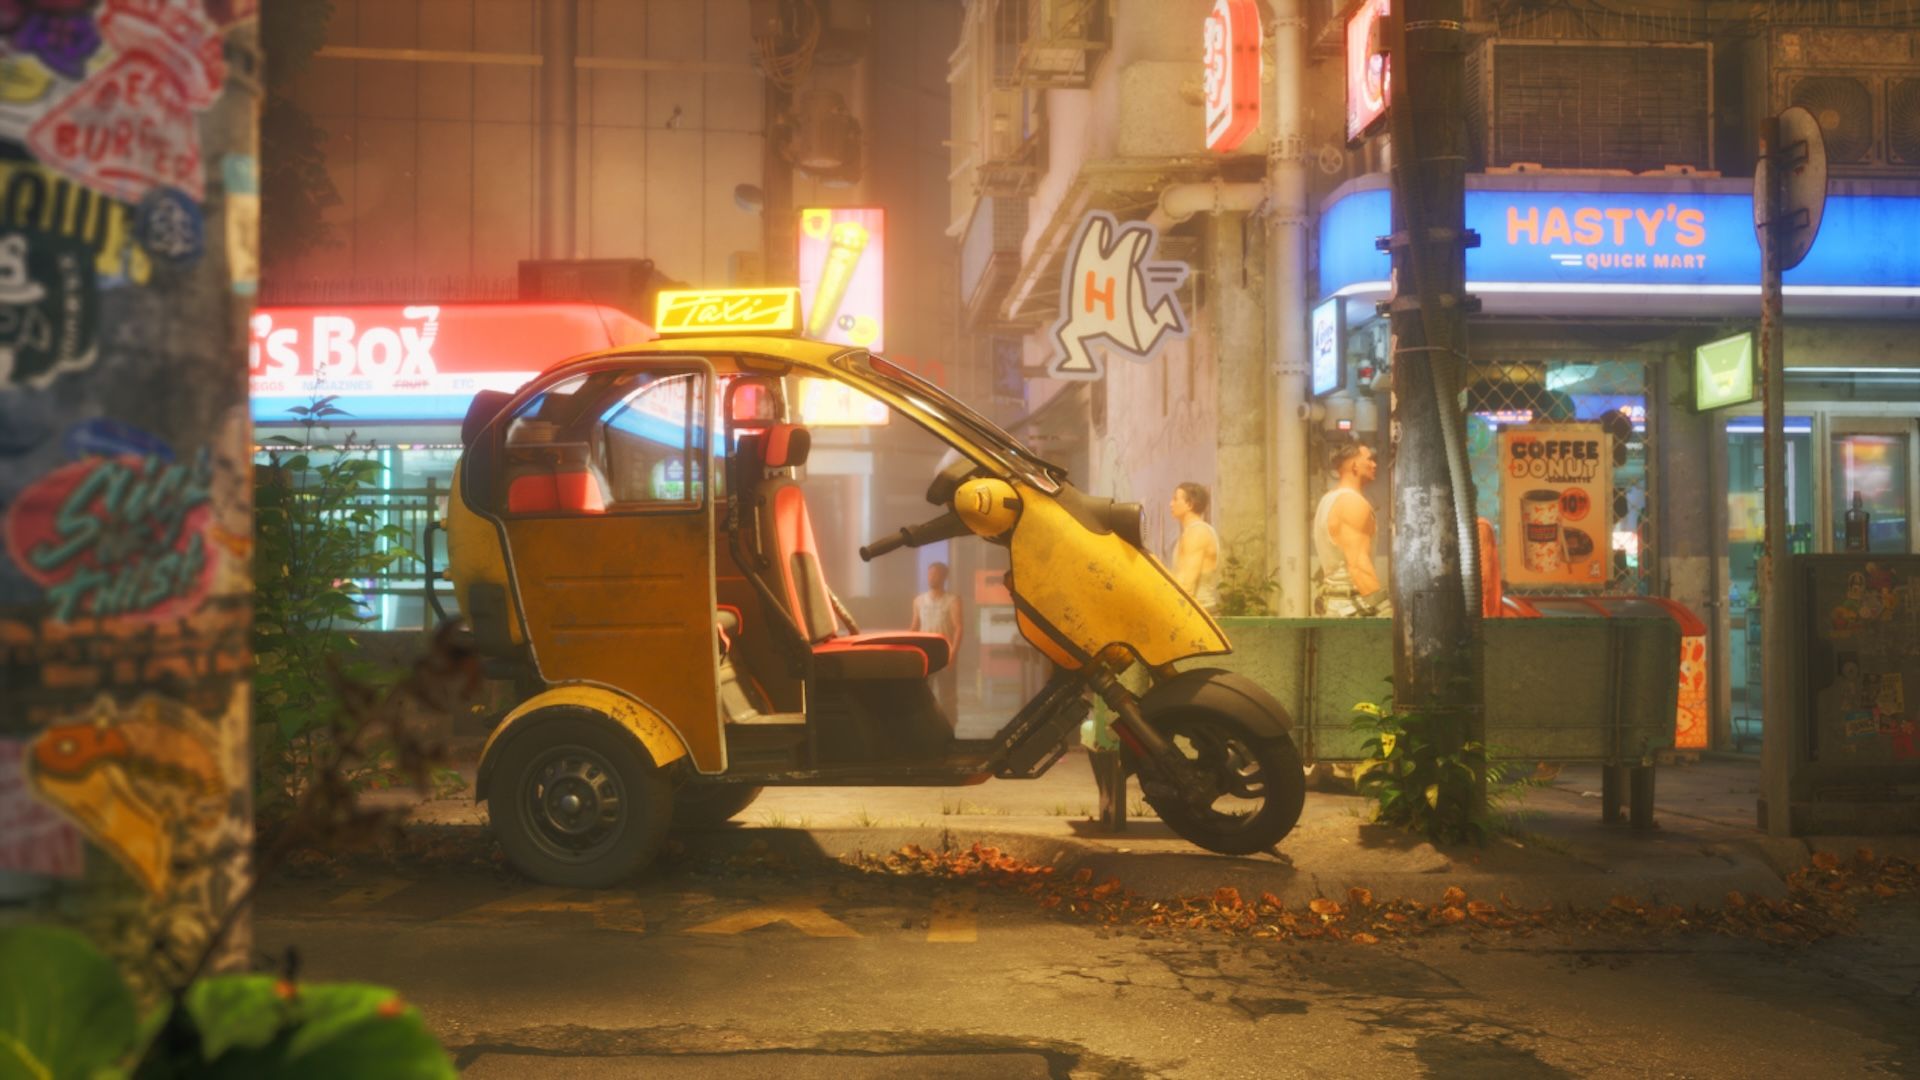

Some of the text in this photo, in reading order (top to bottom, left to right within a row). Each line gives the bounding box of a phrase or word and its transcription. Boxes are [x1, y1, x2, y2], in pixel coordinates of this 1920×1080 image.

[1507, 203, 1706, 247] HASTY'S
[1585, 252, 1706, 270] QUICK MART
[667, 296, 788, 326] Taxi
[1084, 271, 1116, 321] H
[312, 305, 440, 376] Box
[1511, 440, 1599, 459] COFFEE
